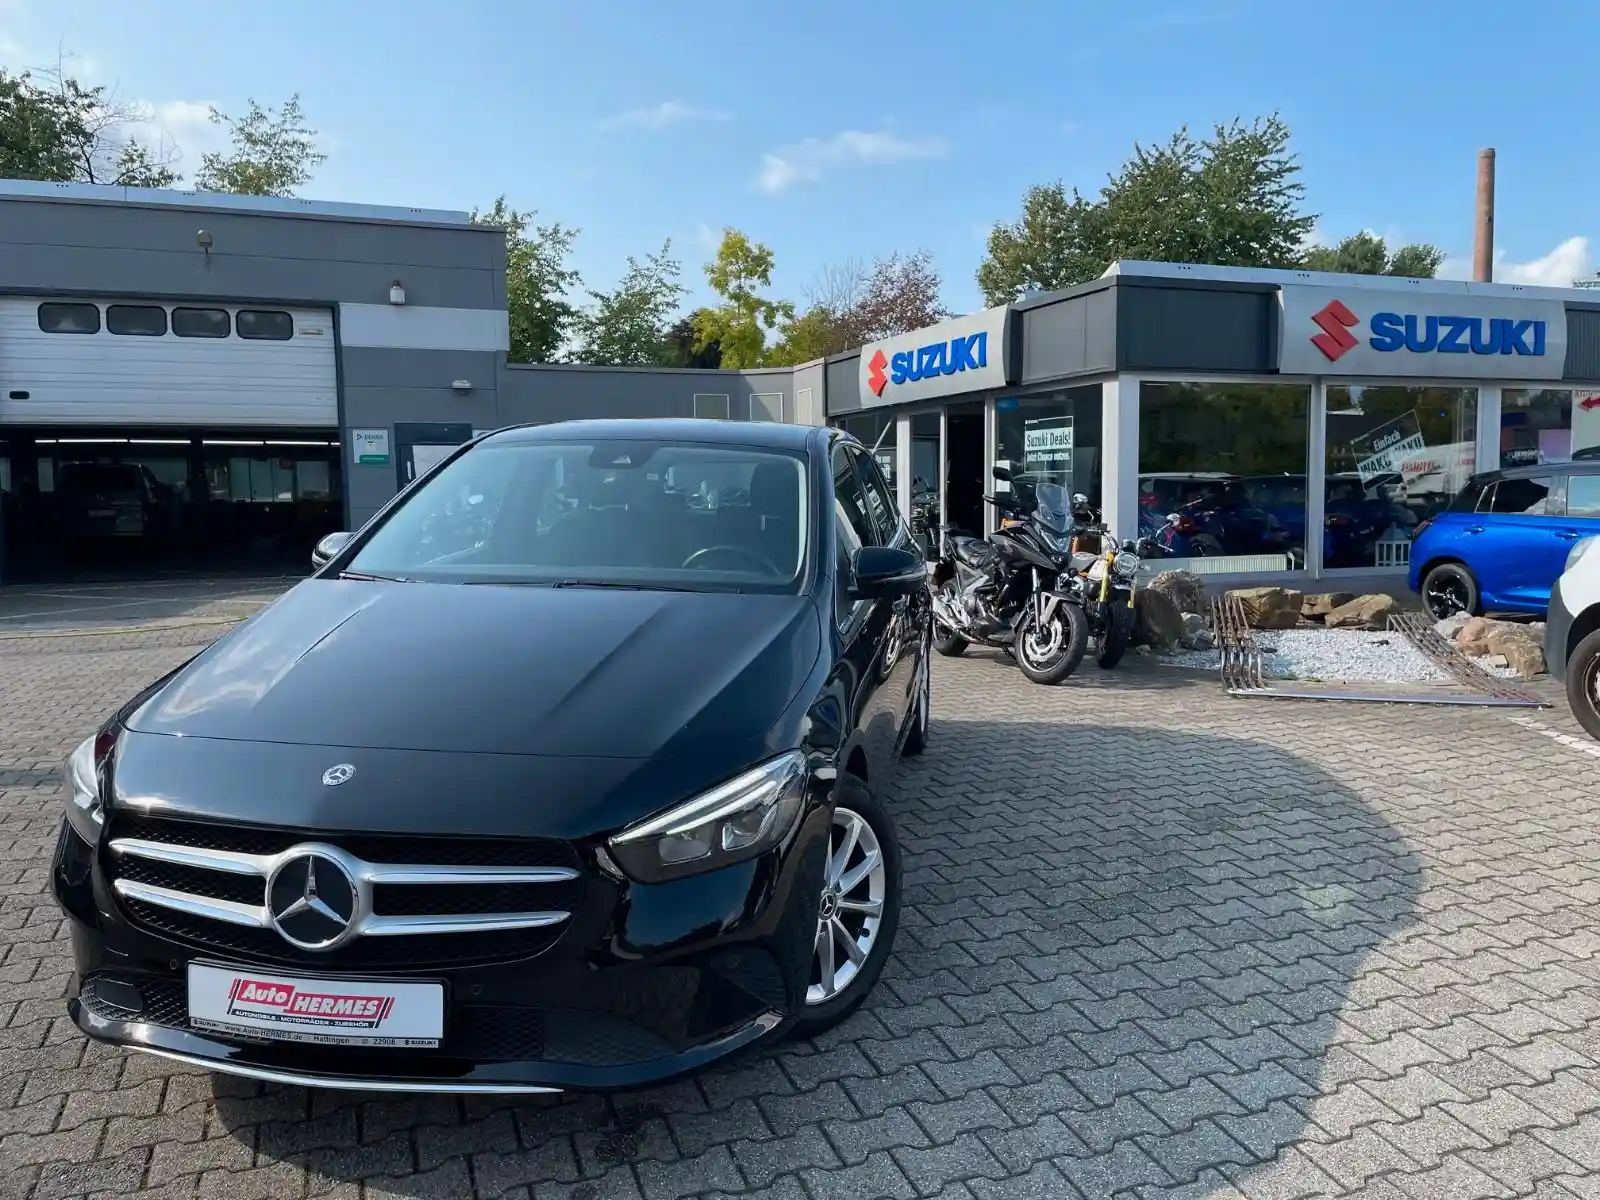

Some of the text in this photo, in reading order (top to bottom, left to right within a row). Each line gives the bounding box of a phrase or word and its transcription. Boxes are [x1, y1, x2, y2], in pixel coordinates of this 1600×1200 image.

[1370, 312, 1546, 356] SUZUKI
[891, 332, 987, 385] SUZUKI
[1026, 431, 1071, 448] Suzuki Deals!
[1373, 430, 1401, 451] Einfach
[1360, 452, 1392, 475] WAKU
[241, 983, 380, 1016] Auto HERMES
[235, 1010, 276, 1021] AUTOMOBILE
